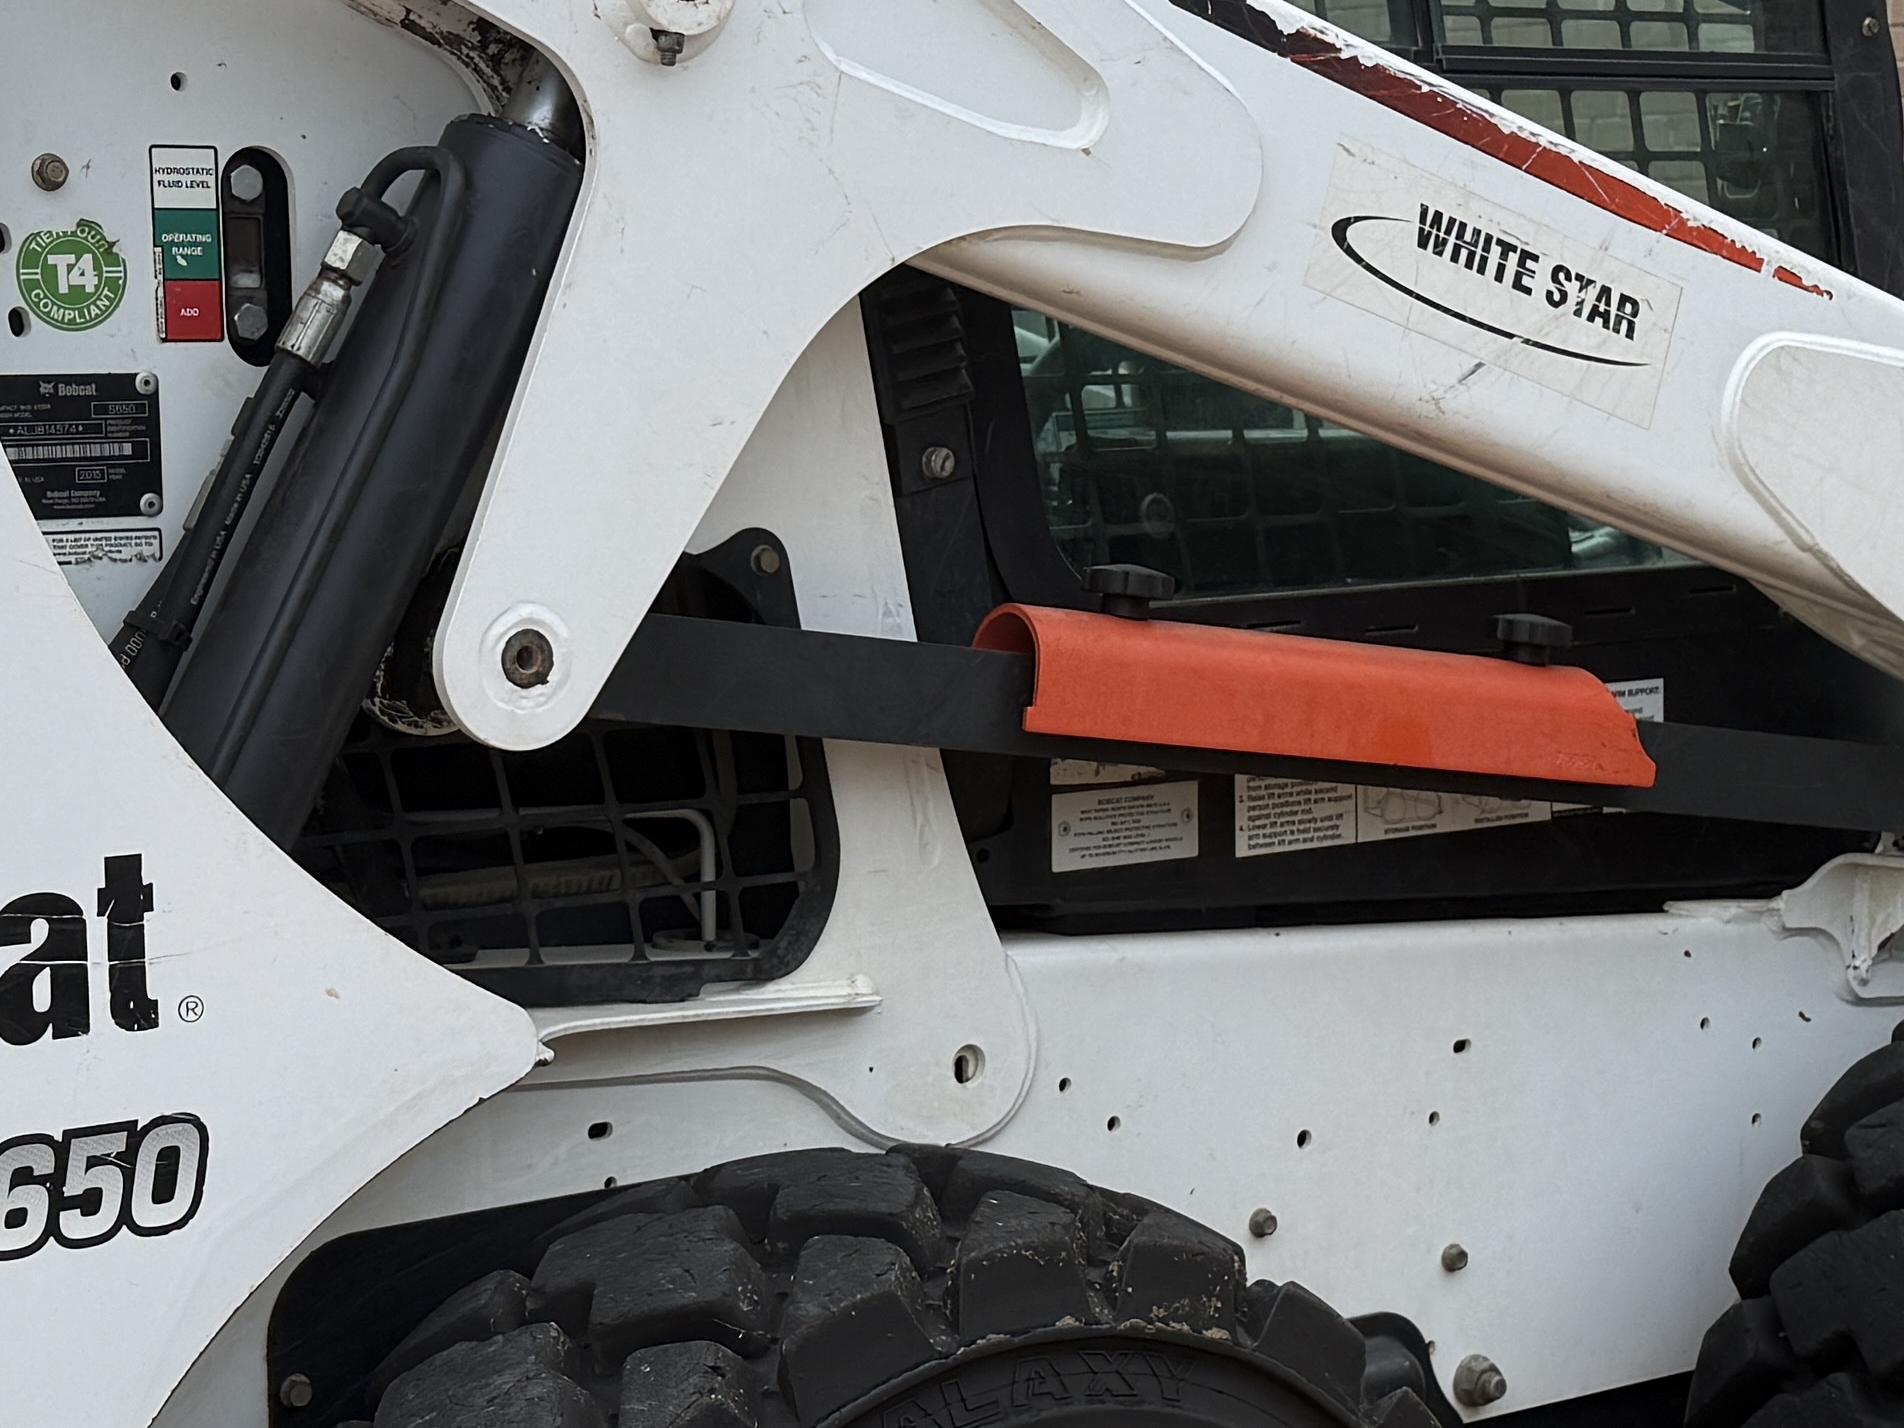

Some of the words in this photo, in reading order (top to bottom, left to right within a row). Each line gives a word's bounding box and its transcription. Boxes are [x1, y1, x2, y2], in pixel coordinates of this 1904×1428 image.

[154, 166, 213, 177] HYDROSTATIC
[157, 180, 183, 189] FLUID
[185, 180, 211, 189] LEVEL
[161, 233, 212, 243] OPERATING
[172, 247, 204, 256] RANGE
[47, 253, 99, 294] T4
[1416, 203, 1540, 297] WHITE
[1545, 263, 1641, 342] STAR
[31, 286, 115, 323] COMPLIANT
[58, 383, 97, 397] Bobcat
